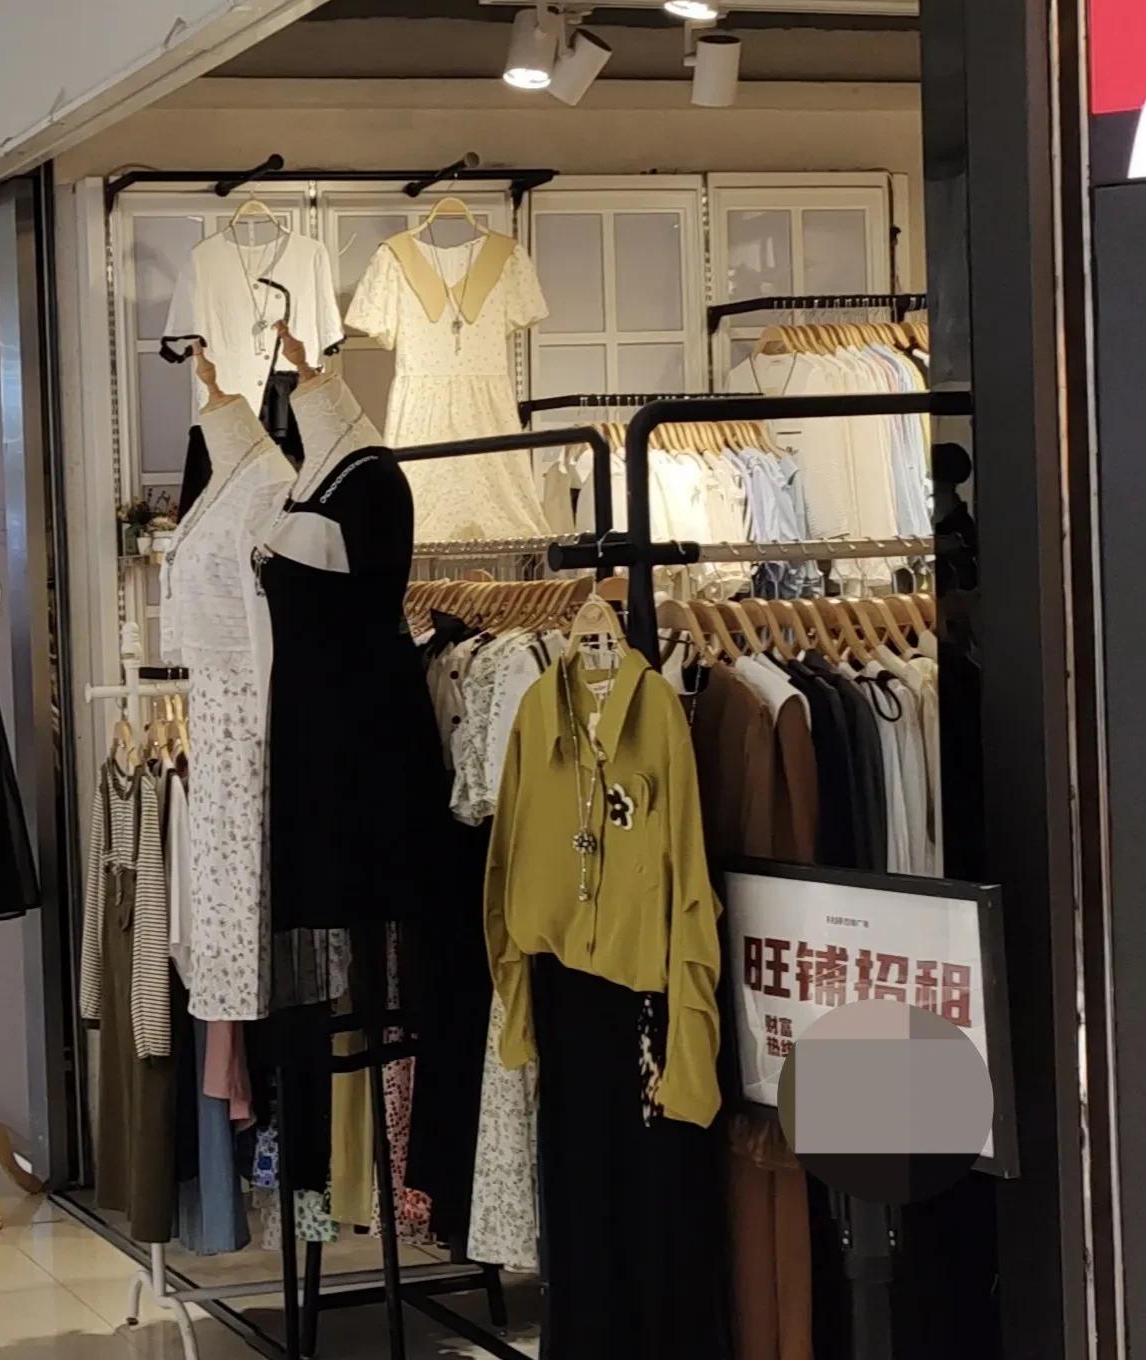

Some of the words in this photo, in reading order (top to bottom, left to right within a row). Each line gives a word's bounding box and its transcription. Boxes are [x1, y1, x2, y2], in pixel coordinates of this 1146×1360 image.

[743, 935, 972, 1028] 旺铺招租
[764, 1014, 793, 1038] 财富
